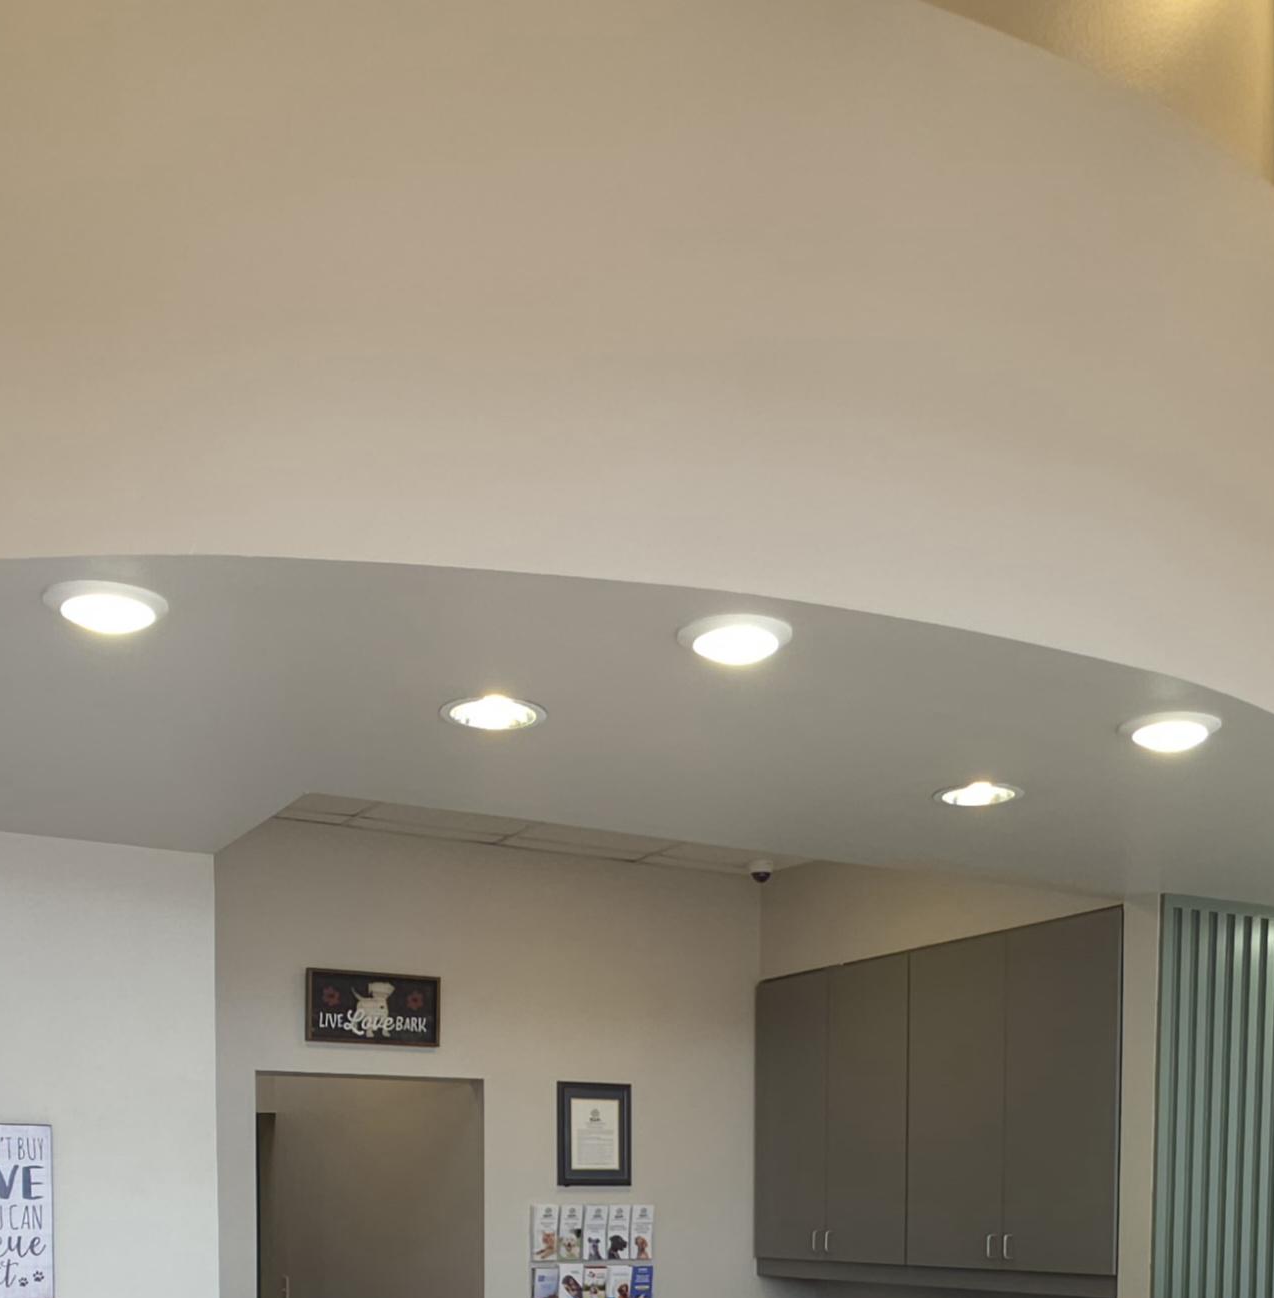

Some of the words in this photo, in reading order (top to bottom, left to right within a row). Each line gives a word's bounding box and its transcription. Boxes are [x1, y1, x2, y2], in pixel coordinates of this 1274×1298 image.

[319, 1011, 344, 1029] LIVE
[343, 1009, 396, 1036] Love
[396, 1016, 427, 1033] BARK
[17, 1137, 44, 1161] BUY
[9, 1204, 43, 1231] CAN
